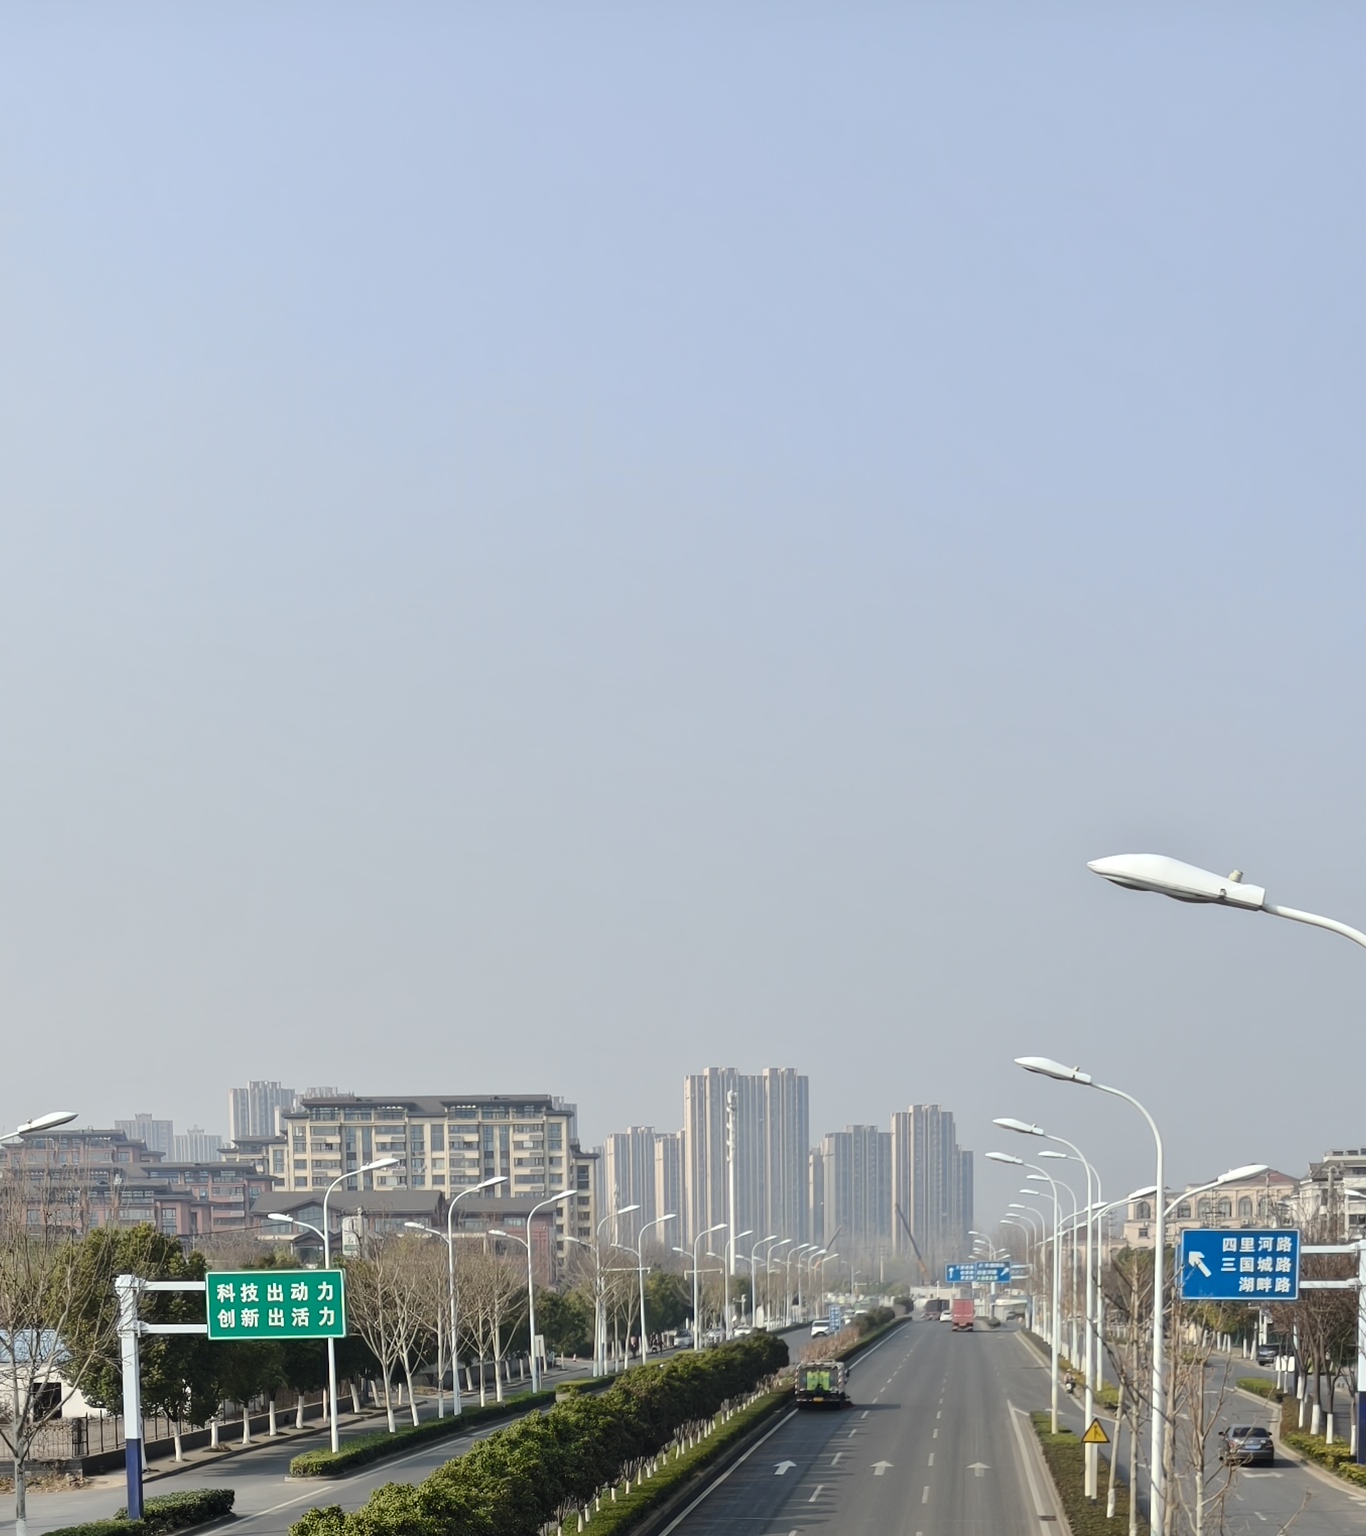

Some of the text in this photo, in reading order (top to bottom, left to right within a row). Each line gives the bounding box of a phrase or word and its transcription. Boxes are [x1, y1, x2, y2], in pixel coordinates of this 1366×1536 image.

[1222, 1236, 1292, 1252] 四里河路
[1221, 1256, 1291, 1272] 三国城路
[216, 1281, 335, 1303] 科技出动力
[1238, 1277, 1291, 1292] 湖畔路
[217, 1307, 336, 1329] 创新出活力
